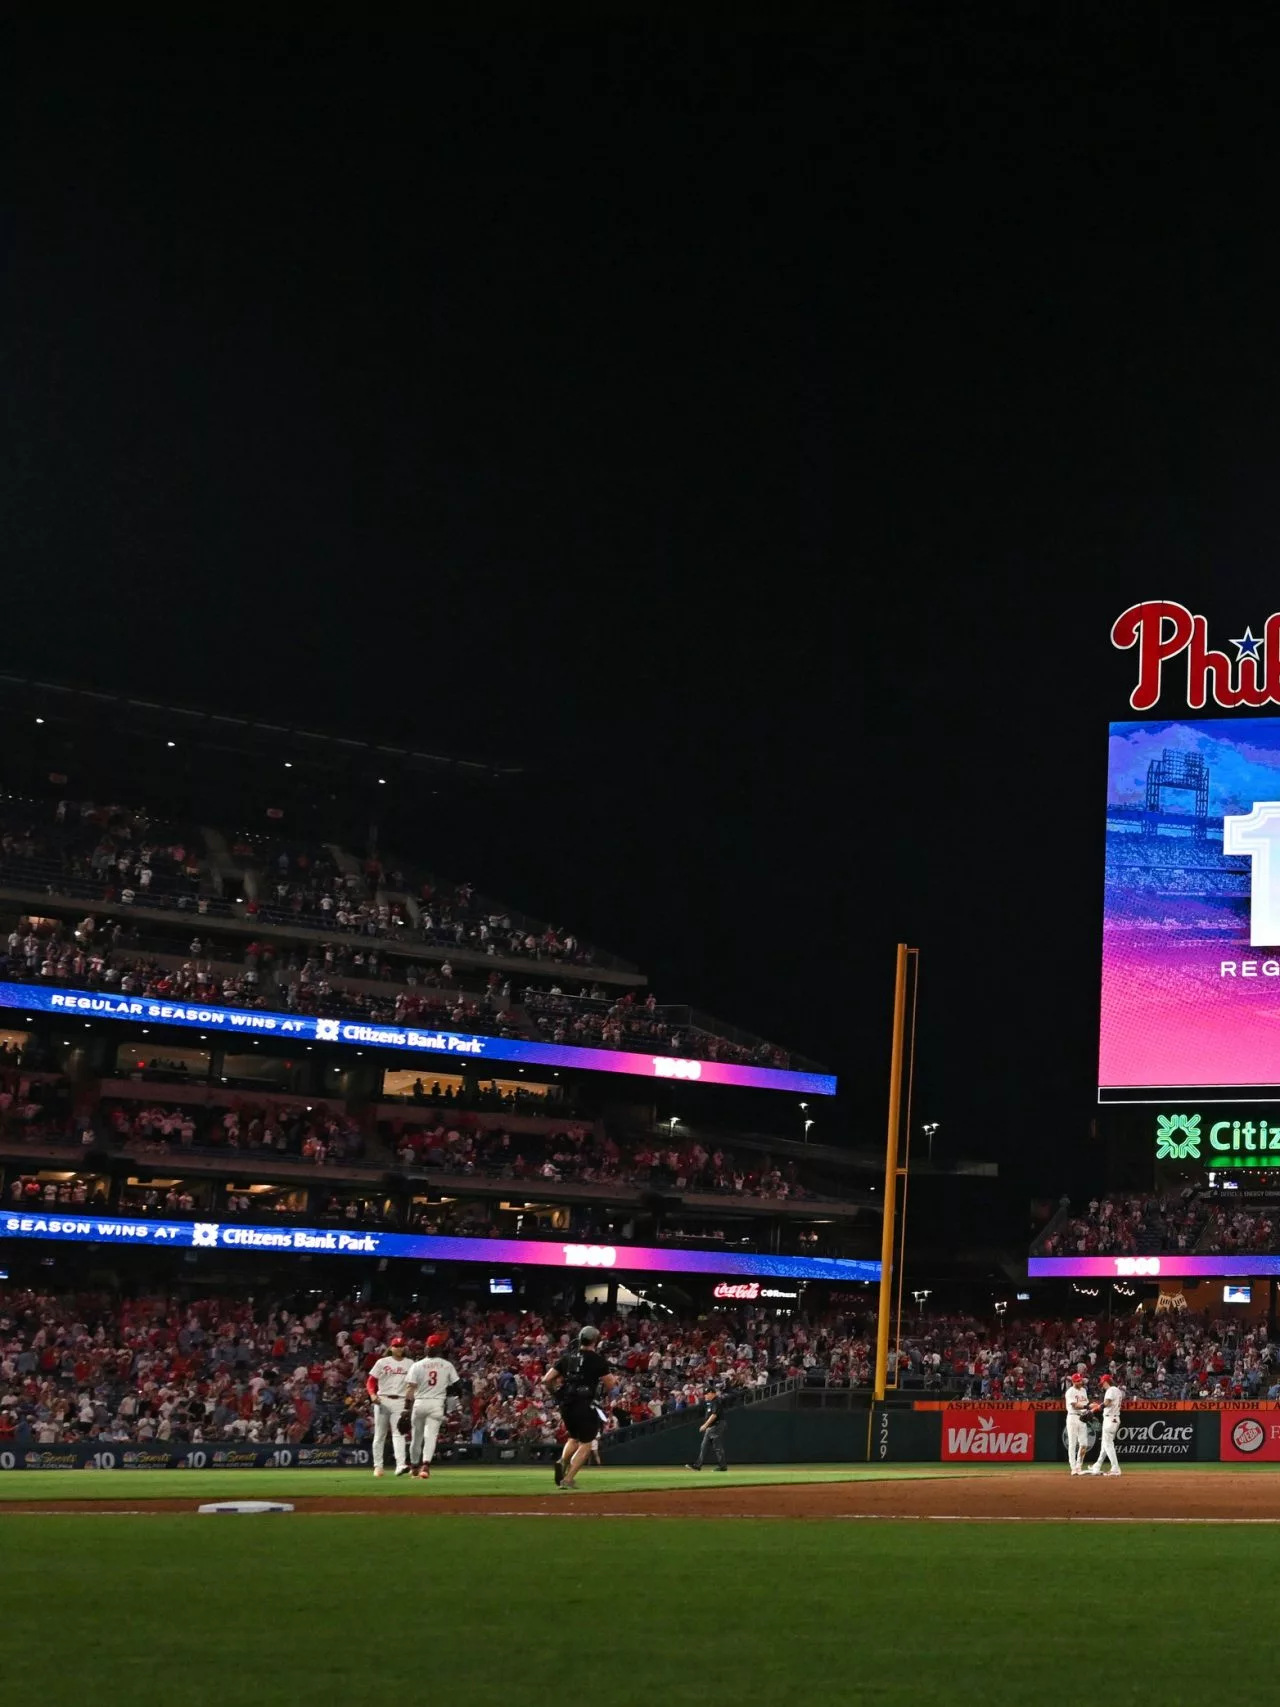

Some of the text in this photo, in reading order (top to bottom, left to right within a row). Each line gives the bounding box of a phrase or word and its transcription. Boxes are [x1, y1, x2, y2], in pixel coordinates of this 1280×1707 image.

[51, 994, 305, 1032] REGULAR SEASON WINS AT
[343, 1025, 482, 1053] Citizens Bank Park
[6, 1218, 180, 1239] SEASON WINS AT
[223, 1228, 376, 1251] Citizens Bank Park
[714, 1282, 760, 1299] Coca-Cola
[428, 1370, 437, 1386] 3
[948, 1402, 1014, 1410] ASPLUNDH
[1028, 1402, 1067, 1410] ASPLU
[1120, 1402, 1177, 1410] SPLUNDH
[1192, 1402, 1259, 1410] ASPLUNDH
[1115, 1420, 1193, 1441] ovaCare
[948, 1428, 1028, 1454] Wawa
[1115, 1444, 1189, 1454] HABILITATION
[93, 1452, 115, 1469] 10
[186, 1451, 206, 1468] 10
[272, 1450, 292, 1467] 10
[352, 1450, 369, 1464] 10
